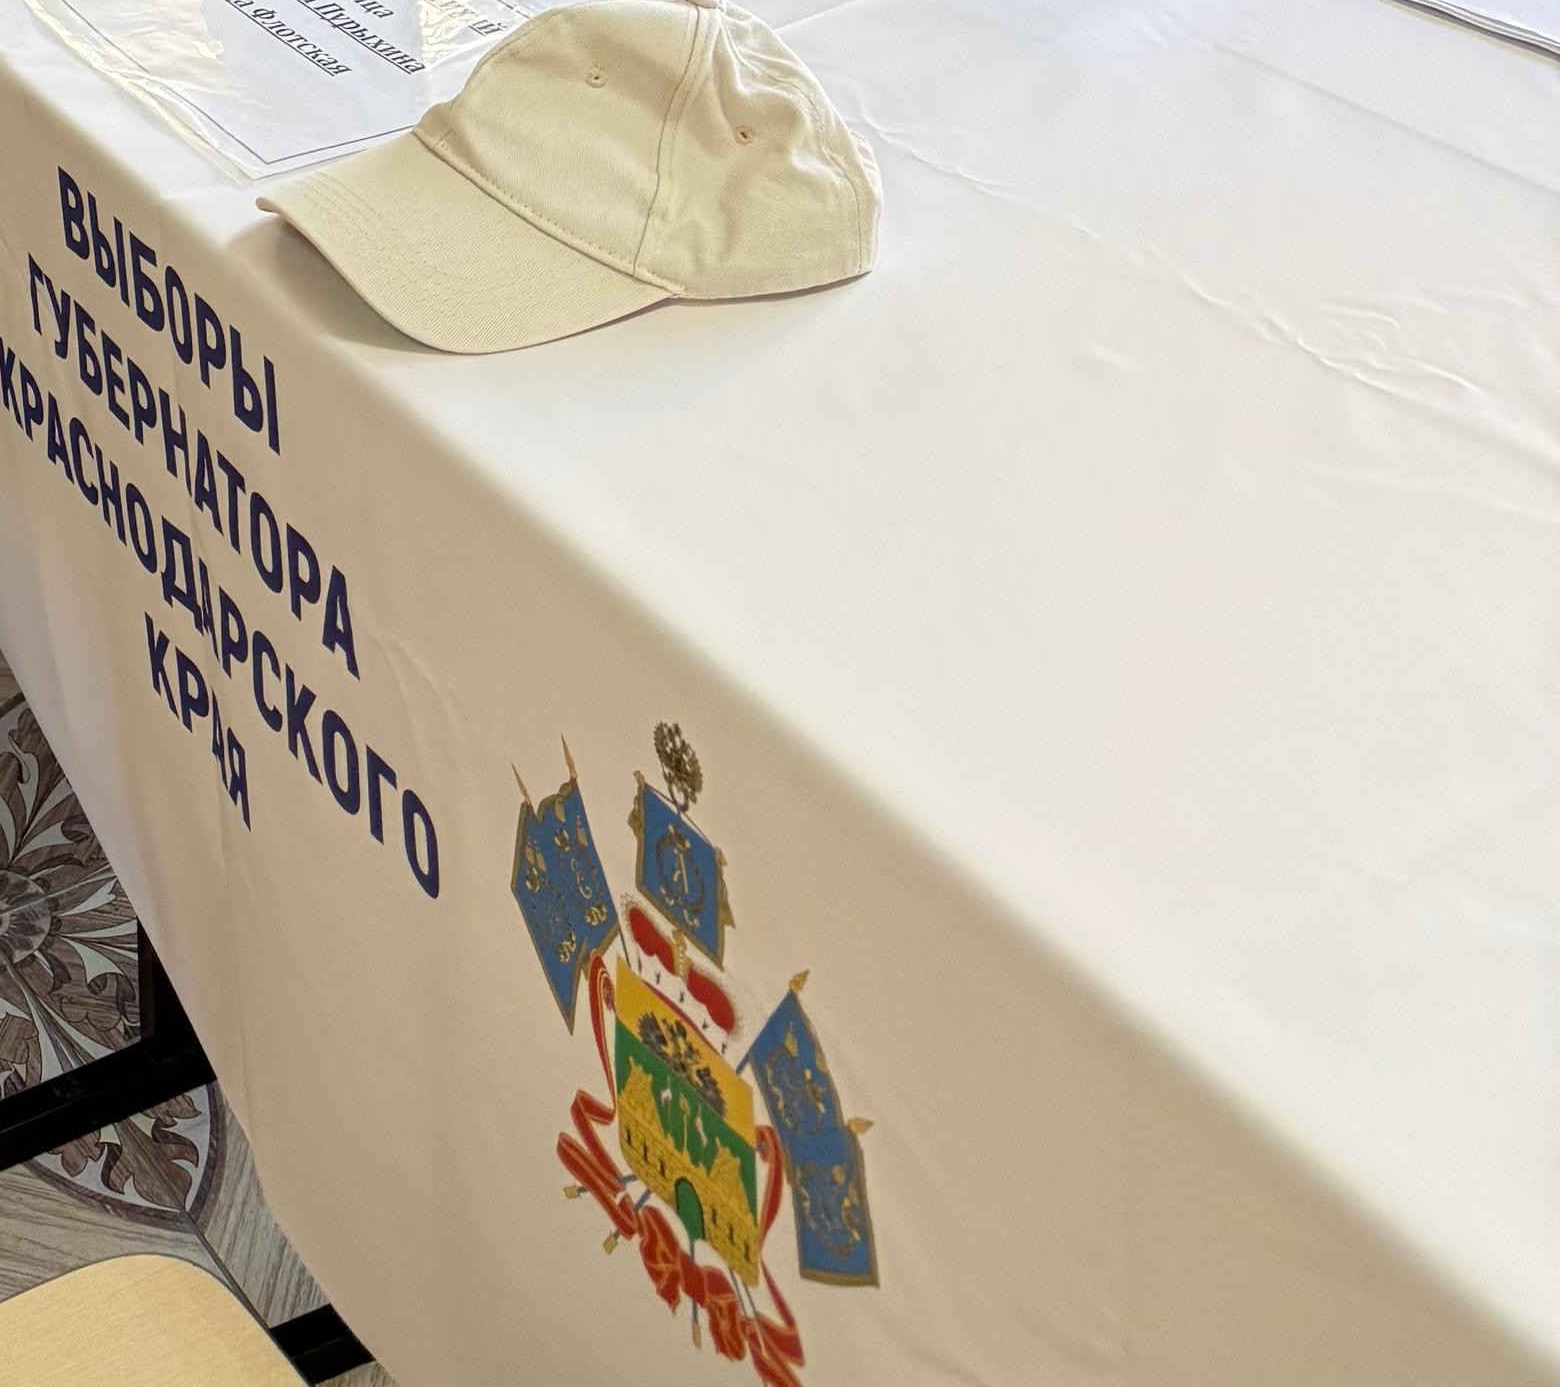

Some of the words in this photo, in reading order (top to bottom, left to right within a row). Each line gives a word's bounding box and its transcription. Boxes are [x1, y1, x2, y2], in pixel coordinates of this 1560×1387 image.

[251, 5, 352, 79] Флотская
[57, 166, 281, 455] ВЫБОРЫ
[27, 253, 360, 681] ГУБЕРНАТОРА
[145, 611, 251, 832] КРАЯ
